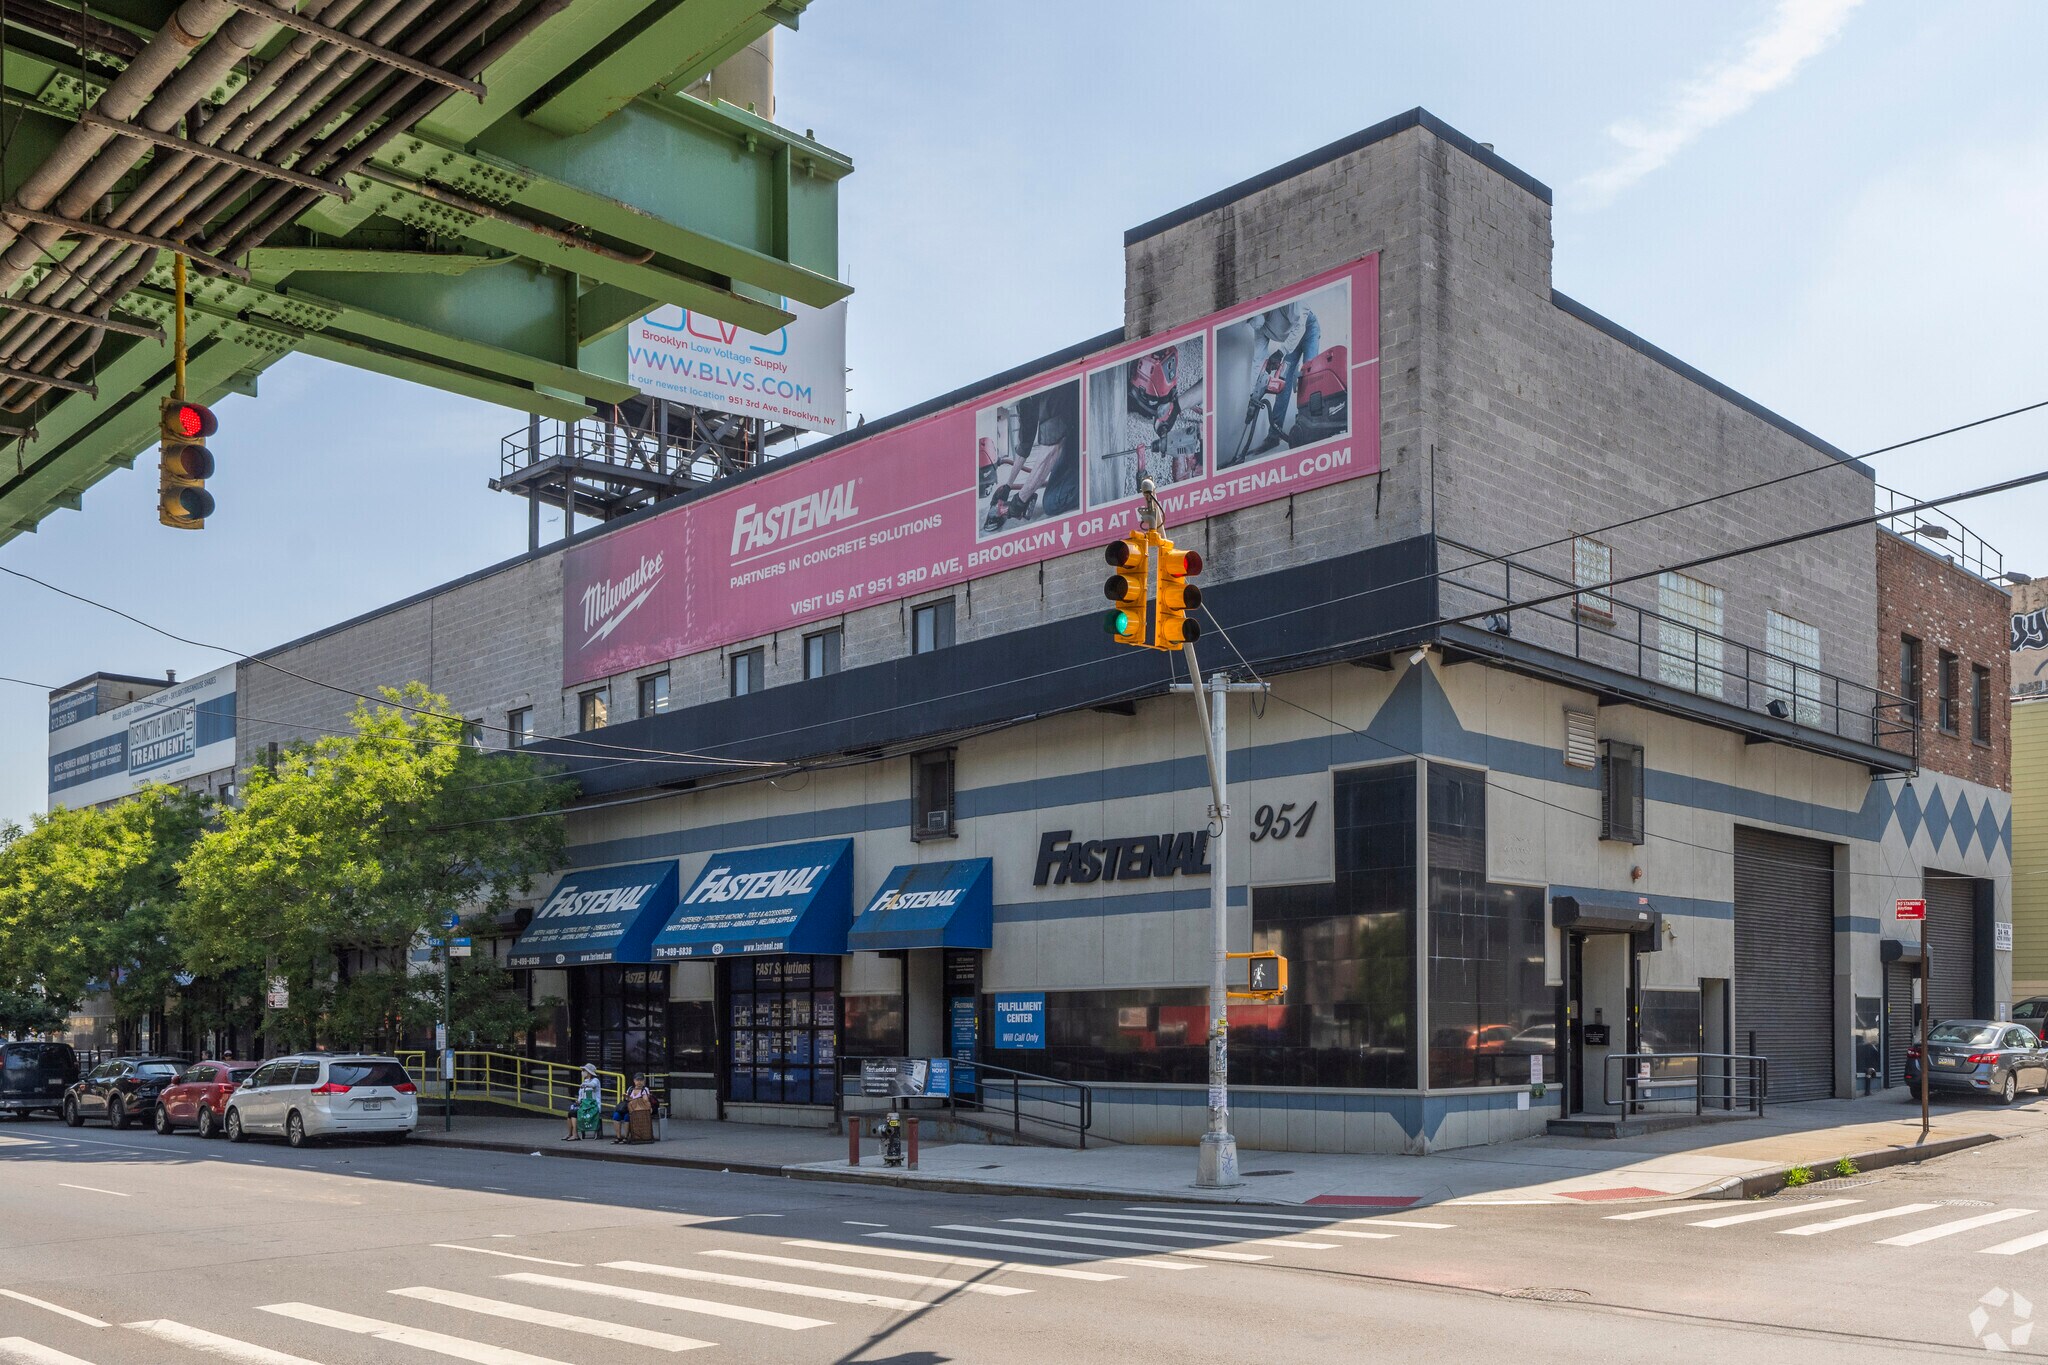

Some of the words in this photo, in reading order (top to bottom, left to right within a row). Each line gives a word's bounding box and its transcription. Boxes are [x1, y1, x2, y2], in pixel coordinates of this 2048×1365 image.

[642, 329, 688, 350] Brooklyn
[690, 342, 712, 355] Low
[713, 346, 752, 365] Voltage
[753, 356, 788, 374] Supply
[638, 376, 654, 385] our
[655, 380, 688, 394] newest
[689, 386, 726, 402] location
[728, 395, 744, 406] 951
[745, 398, 761, 410] 3rd
[762, 402, 781, 414] Ave.
[782, 406, 822, 425] Brooklyn,
[823, 416, 837, 427] NY
[730, 564, 788, 590] PARTNERS
[788, 558, 801, 574] IN
[802, 536, 867, 568] CONCRETE
[869, 514, 943, 548] SOLUTIONS
[790, 594, 824, 617] VISIT
[825, 588, 846, 606] US
[847, 582, 865, 601] AT
[867, 576, 894, 596] 951
[896, 567, 928, 588] 3RD
[930, 556, 964, 580] AVE,
[967, 528, 1057, 569] BROOKLYN
[1077, 517, 1104, 538] OR
[1106, 509, 1131, 531] AT
[579, 552, 664, 633] Milwaukee
[129, 717, 161, 747] DISTINCTIVE
[162, 708, 186, 736] WINDOW
[132, 735, 185, 767] TREATMENT
[1249, 801, 1318, 843] 951
[1033, 829, 1212, 886] FASTENAL
[537, 884, 652, 919] FASTENAL
[683, 865, 824, 906] FASTENAL
[868, 888, 962, 911] FASTENAL
[743, 941, 784, 952] www.fastenal.com
[755, 962, 774, 975] FAST
[997, 1001, 1043, 1012] FULFILLMENT
[1006, 1013, 1033, 1023] CENTER
[1003, 1033, 1014, 1042] Will
[1014, 1033, 1026, 1042] Call
[1025, 1033, 1040, 1043] Only
